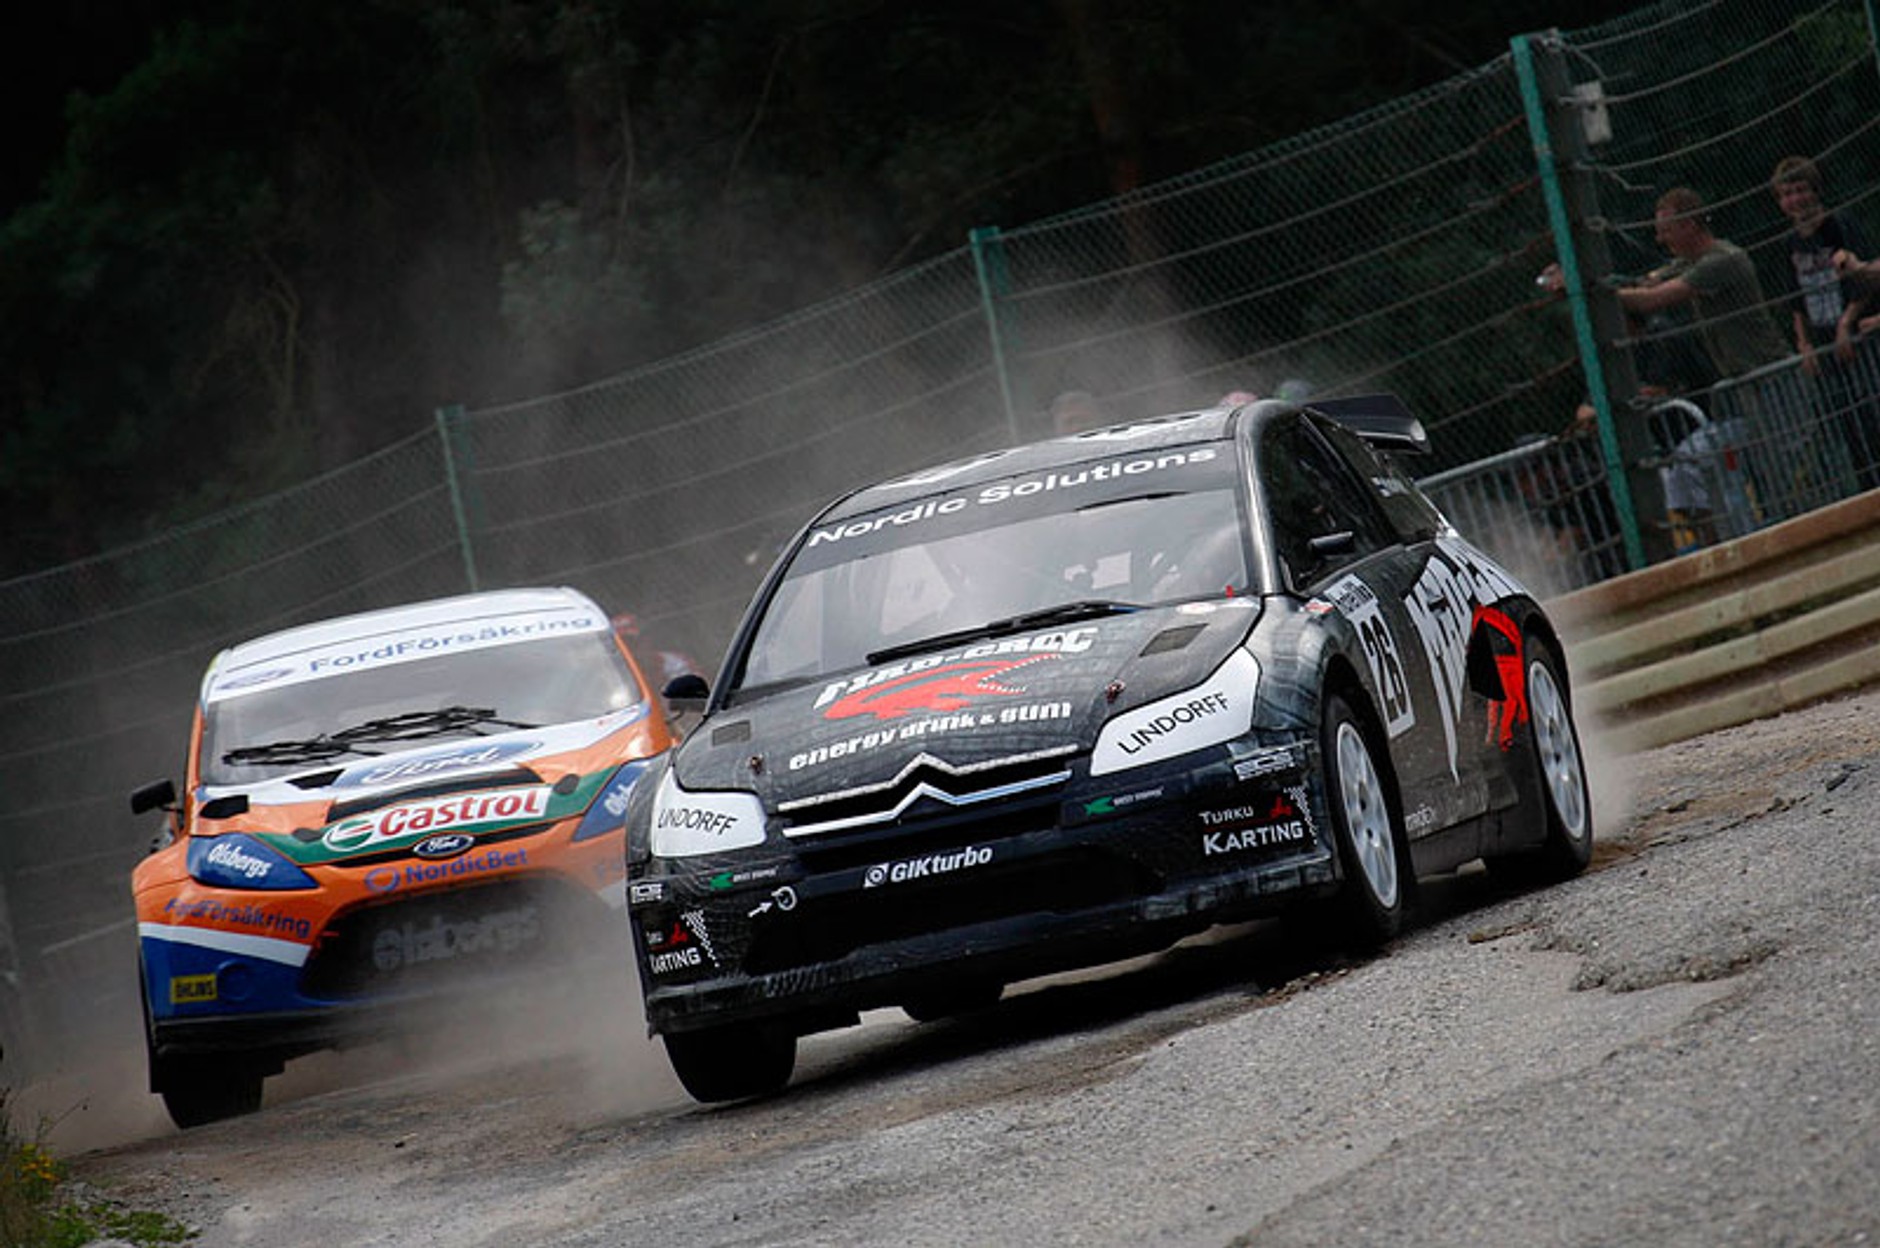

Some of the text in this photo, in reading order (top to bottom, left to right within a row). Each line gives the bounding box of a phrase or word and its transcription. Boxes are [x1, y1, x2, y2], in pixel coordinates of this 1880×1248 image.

[808, 497, 967, 547] Nordic
[976, 447, 1216, 505] Solutions
[900, 716, 976, 740] drink
[1117, 692, 1229, 755] LINDORFF
[378, 790, 541, 838] Castrol
[657, 807, 739, 836] LINDORFF
[1203, 821, 1305, 856] KARTING
[404, 848, 529, 885] NordicBet
[890, 846, 994, 883] GIKturbo
